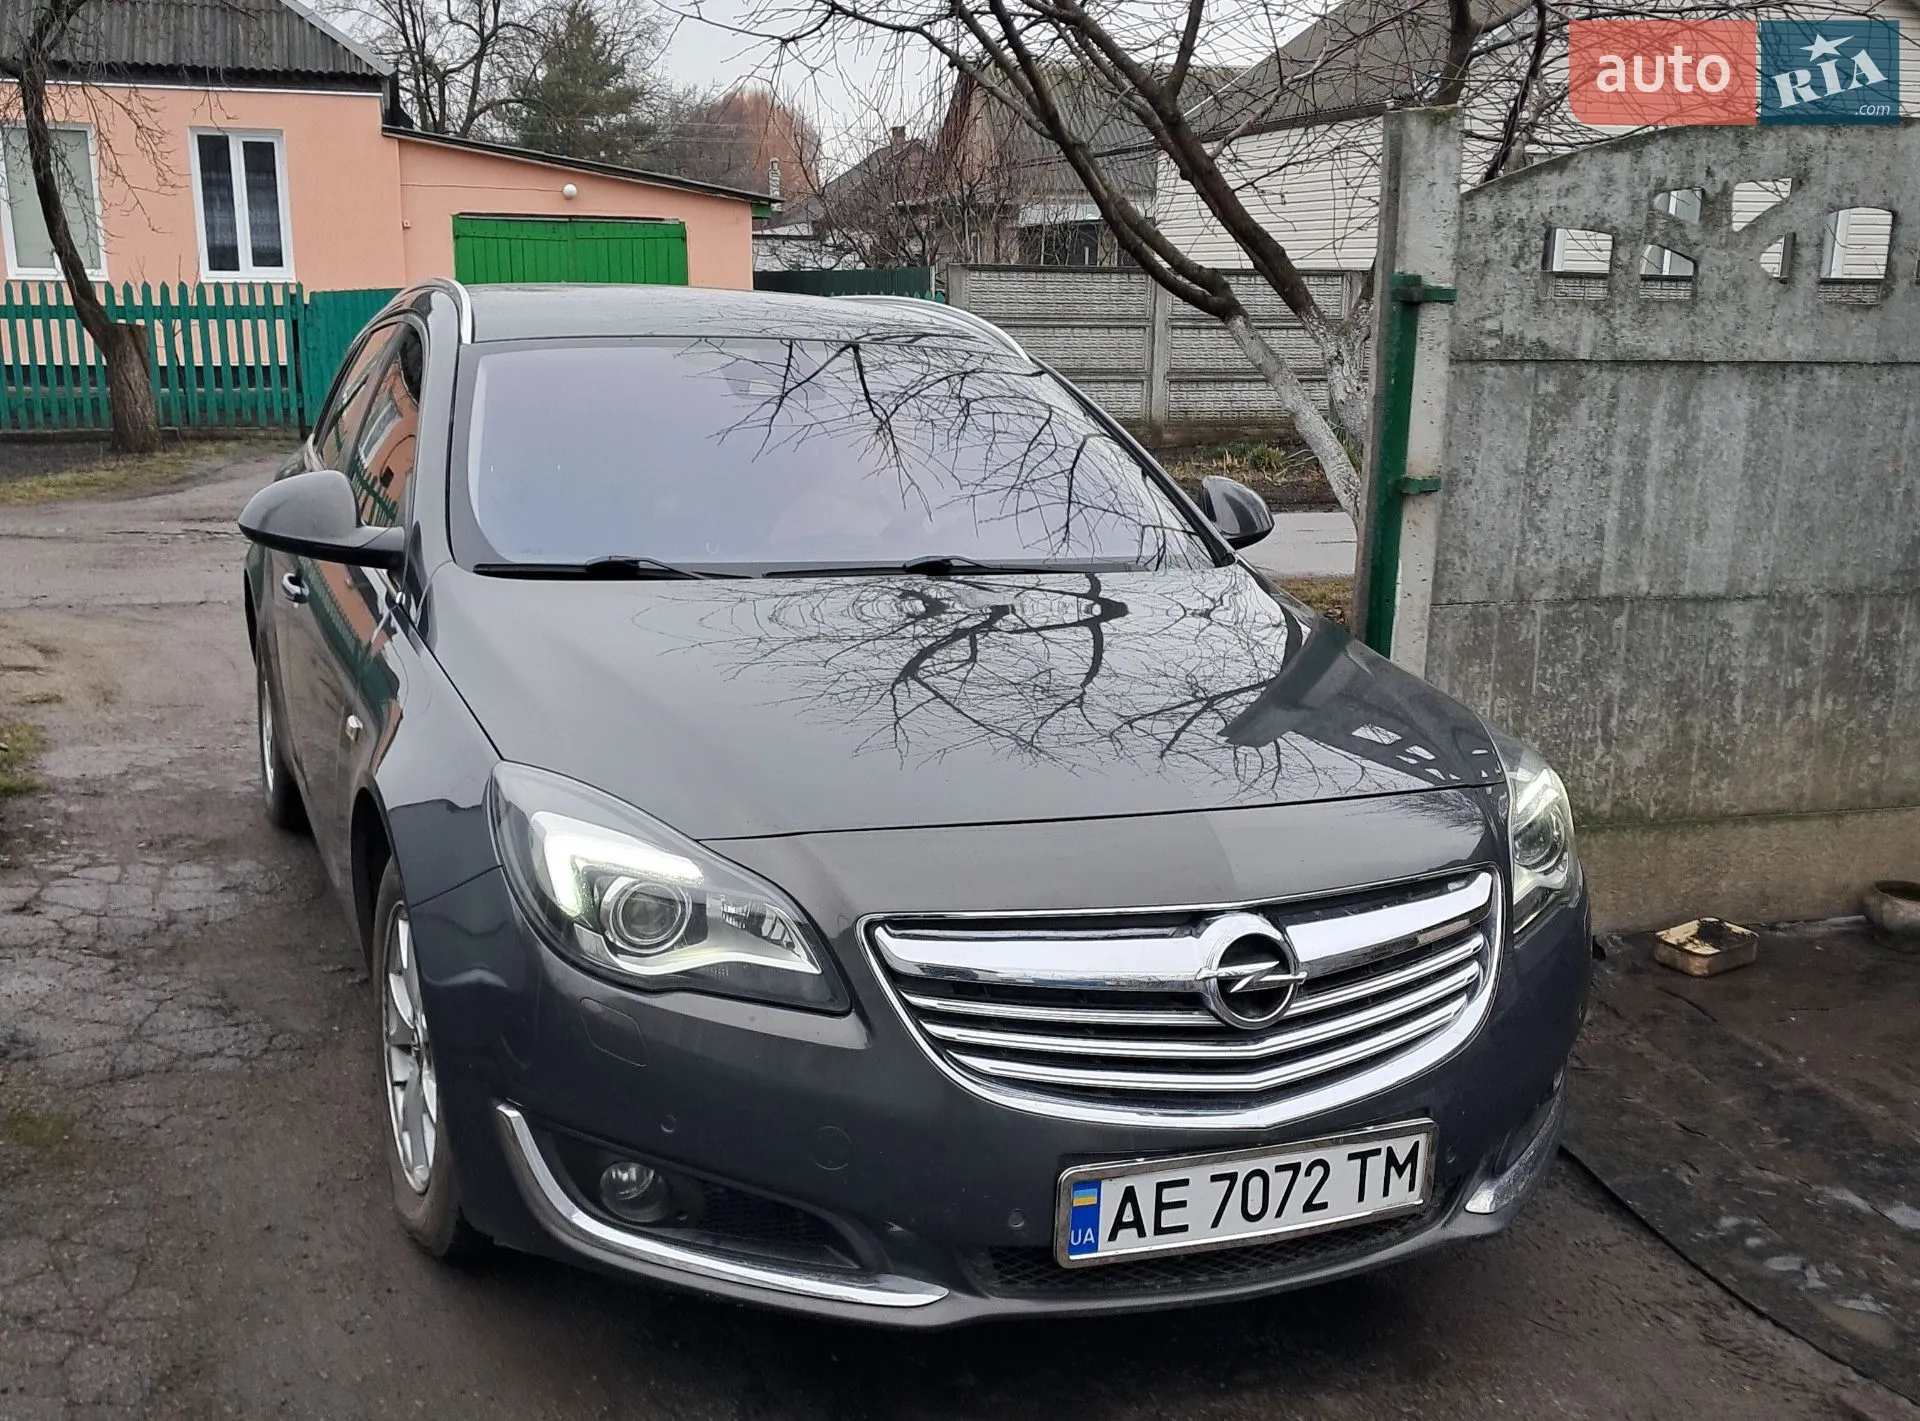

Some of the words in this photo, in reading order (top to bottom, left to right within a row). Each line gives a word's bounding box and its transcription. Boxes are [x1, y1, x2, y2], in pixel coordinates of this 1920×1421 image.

[1107, 1178, 1190, 1242] AE
[1209, 1157, 1331, 1230] 7072
[1347, 1140, 1421, 1203] TM
[1069, 1227, 1095, 1246] UA
